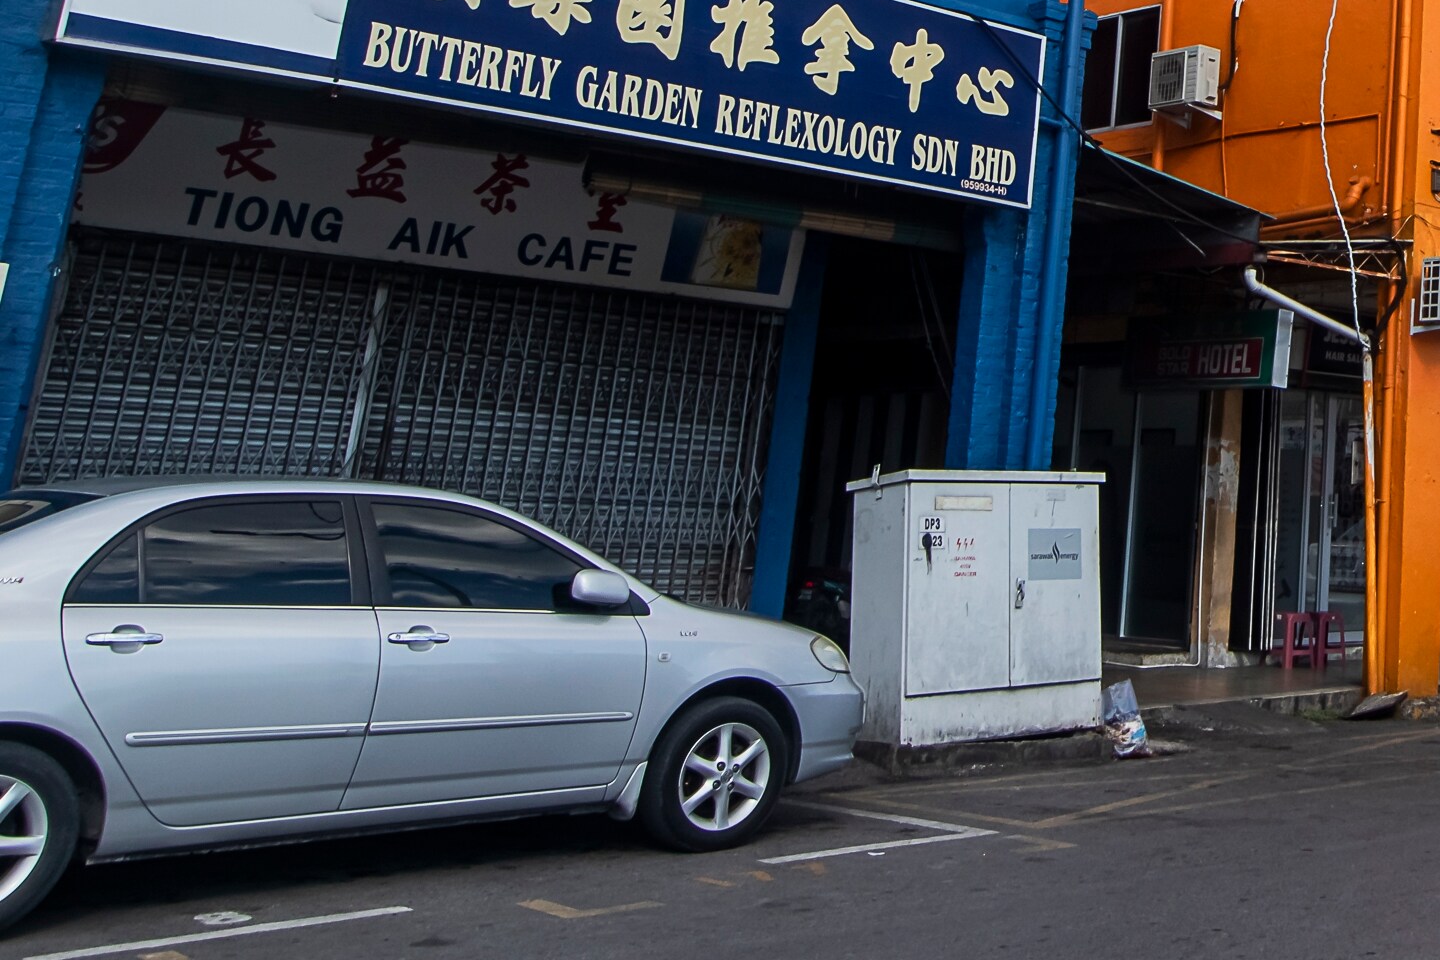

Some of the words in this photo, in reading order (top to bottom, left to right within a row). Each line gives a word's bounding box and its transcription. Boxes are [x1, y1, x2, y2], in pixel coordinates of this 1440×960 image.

[363, 21, 562, 101] BUTTERFLY
[576, 65, 703, 129] GARDEN
[714, 94, 902, 166] REFLEXOLOGY
[911, 133, 960, 177] SDN
[969, 144, 1017, 186] BHD
[960, 178, 1007, 196] (959934-H)
[185, 186, 343, 243] TIONG
[387, 217, 476, 259] AIK
[517, 233, 637, 277] CAFE
[1197, 343, 1252, 375] HOTEL
[1346, 352, 1362, 363] SAL
[924, 518, 941, 530] DP3
[1030, 553, 1053, 561] sarawak
[1059, 552, 1079, 562] energy
